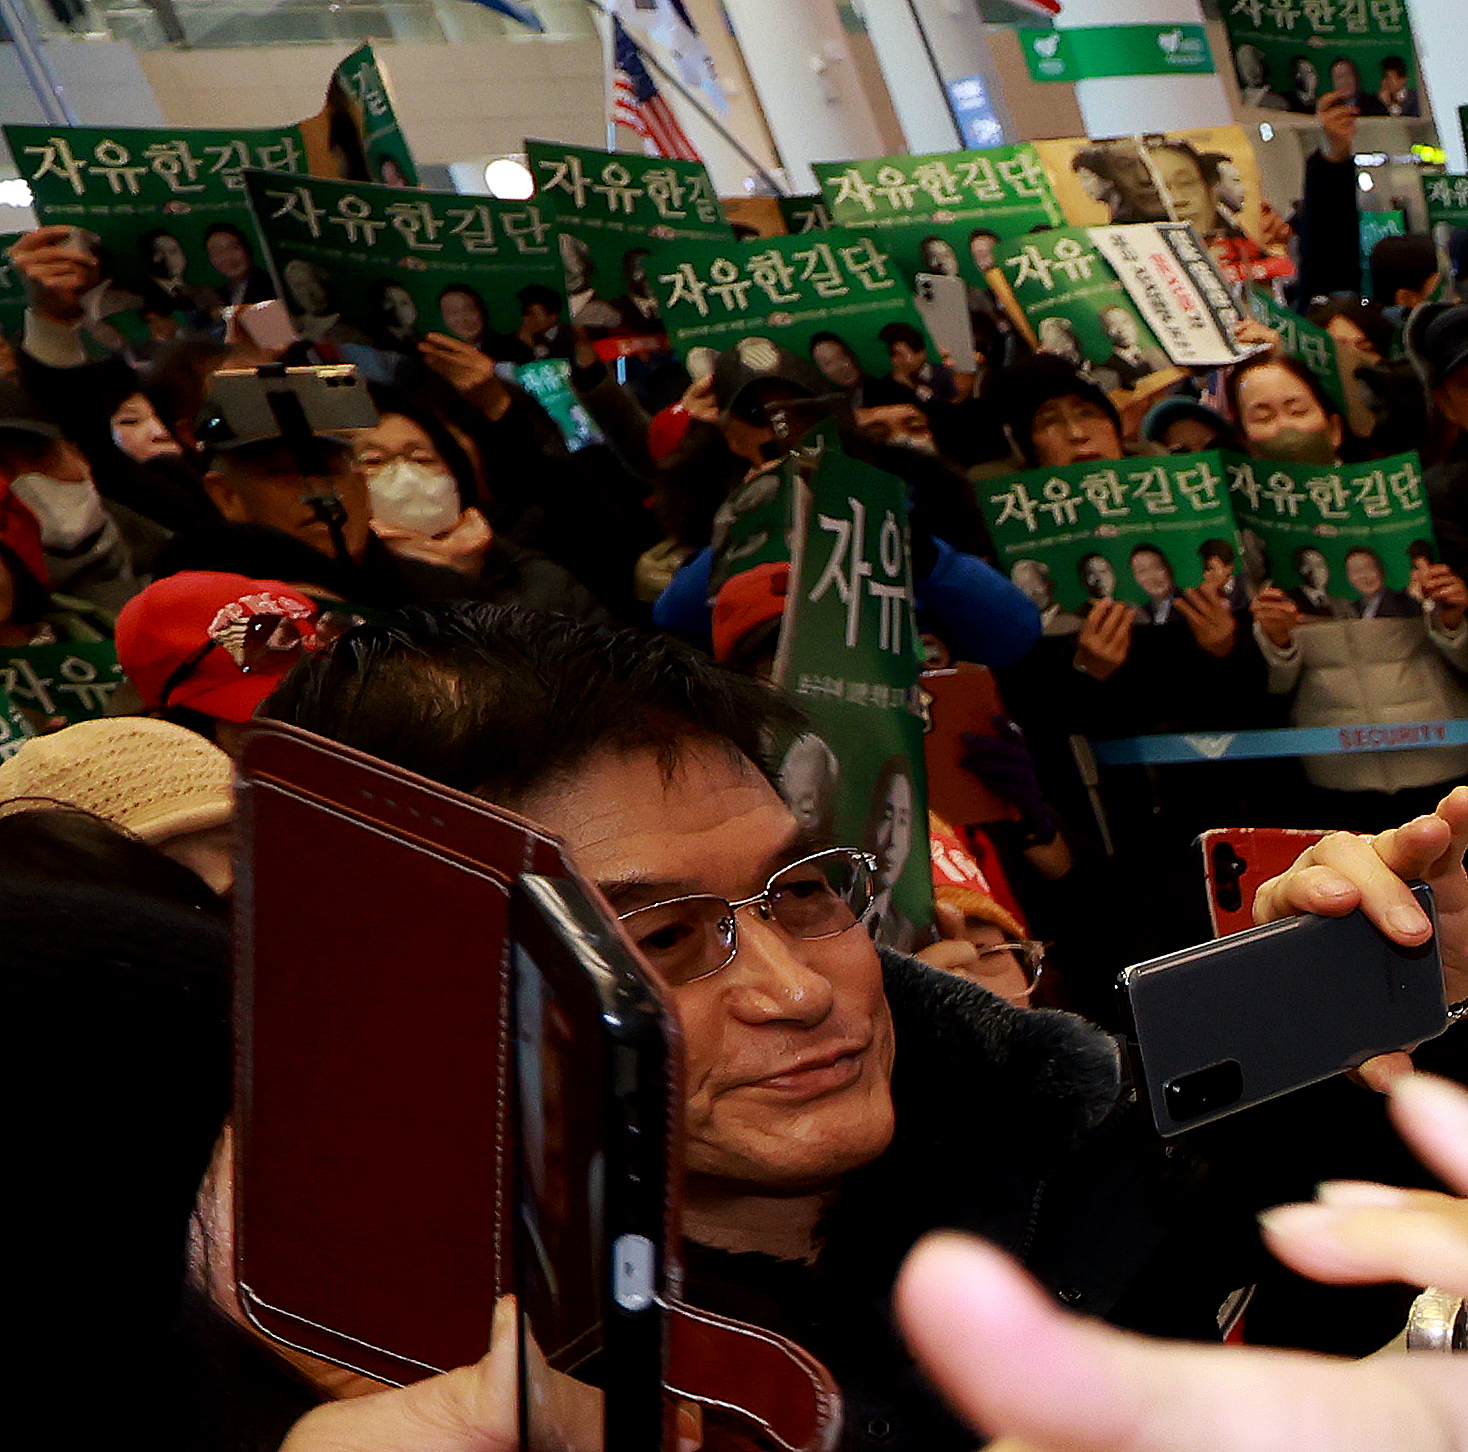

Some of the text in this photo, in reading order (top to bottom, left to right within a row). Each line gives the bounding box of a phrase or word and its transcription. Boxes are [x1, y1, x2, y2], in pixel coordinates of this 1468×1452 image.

[824, 152, 1045, 213] 자유한길단
[265, 186, 551, 254] 자유한길단
[657, 236, 895, 317] 자유한길단
[990, 462, 1221, 532] 자유한길단
[1227, 463, 1422, 518] 자유한길단
